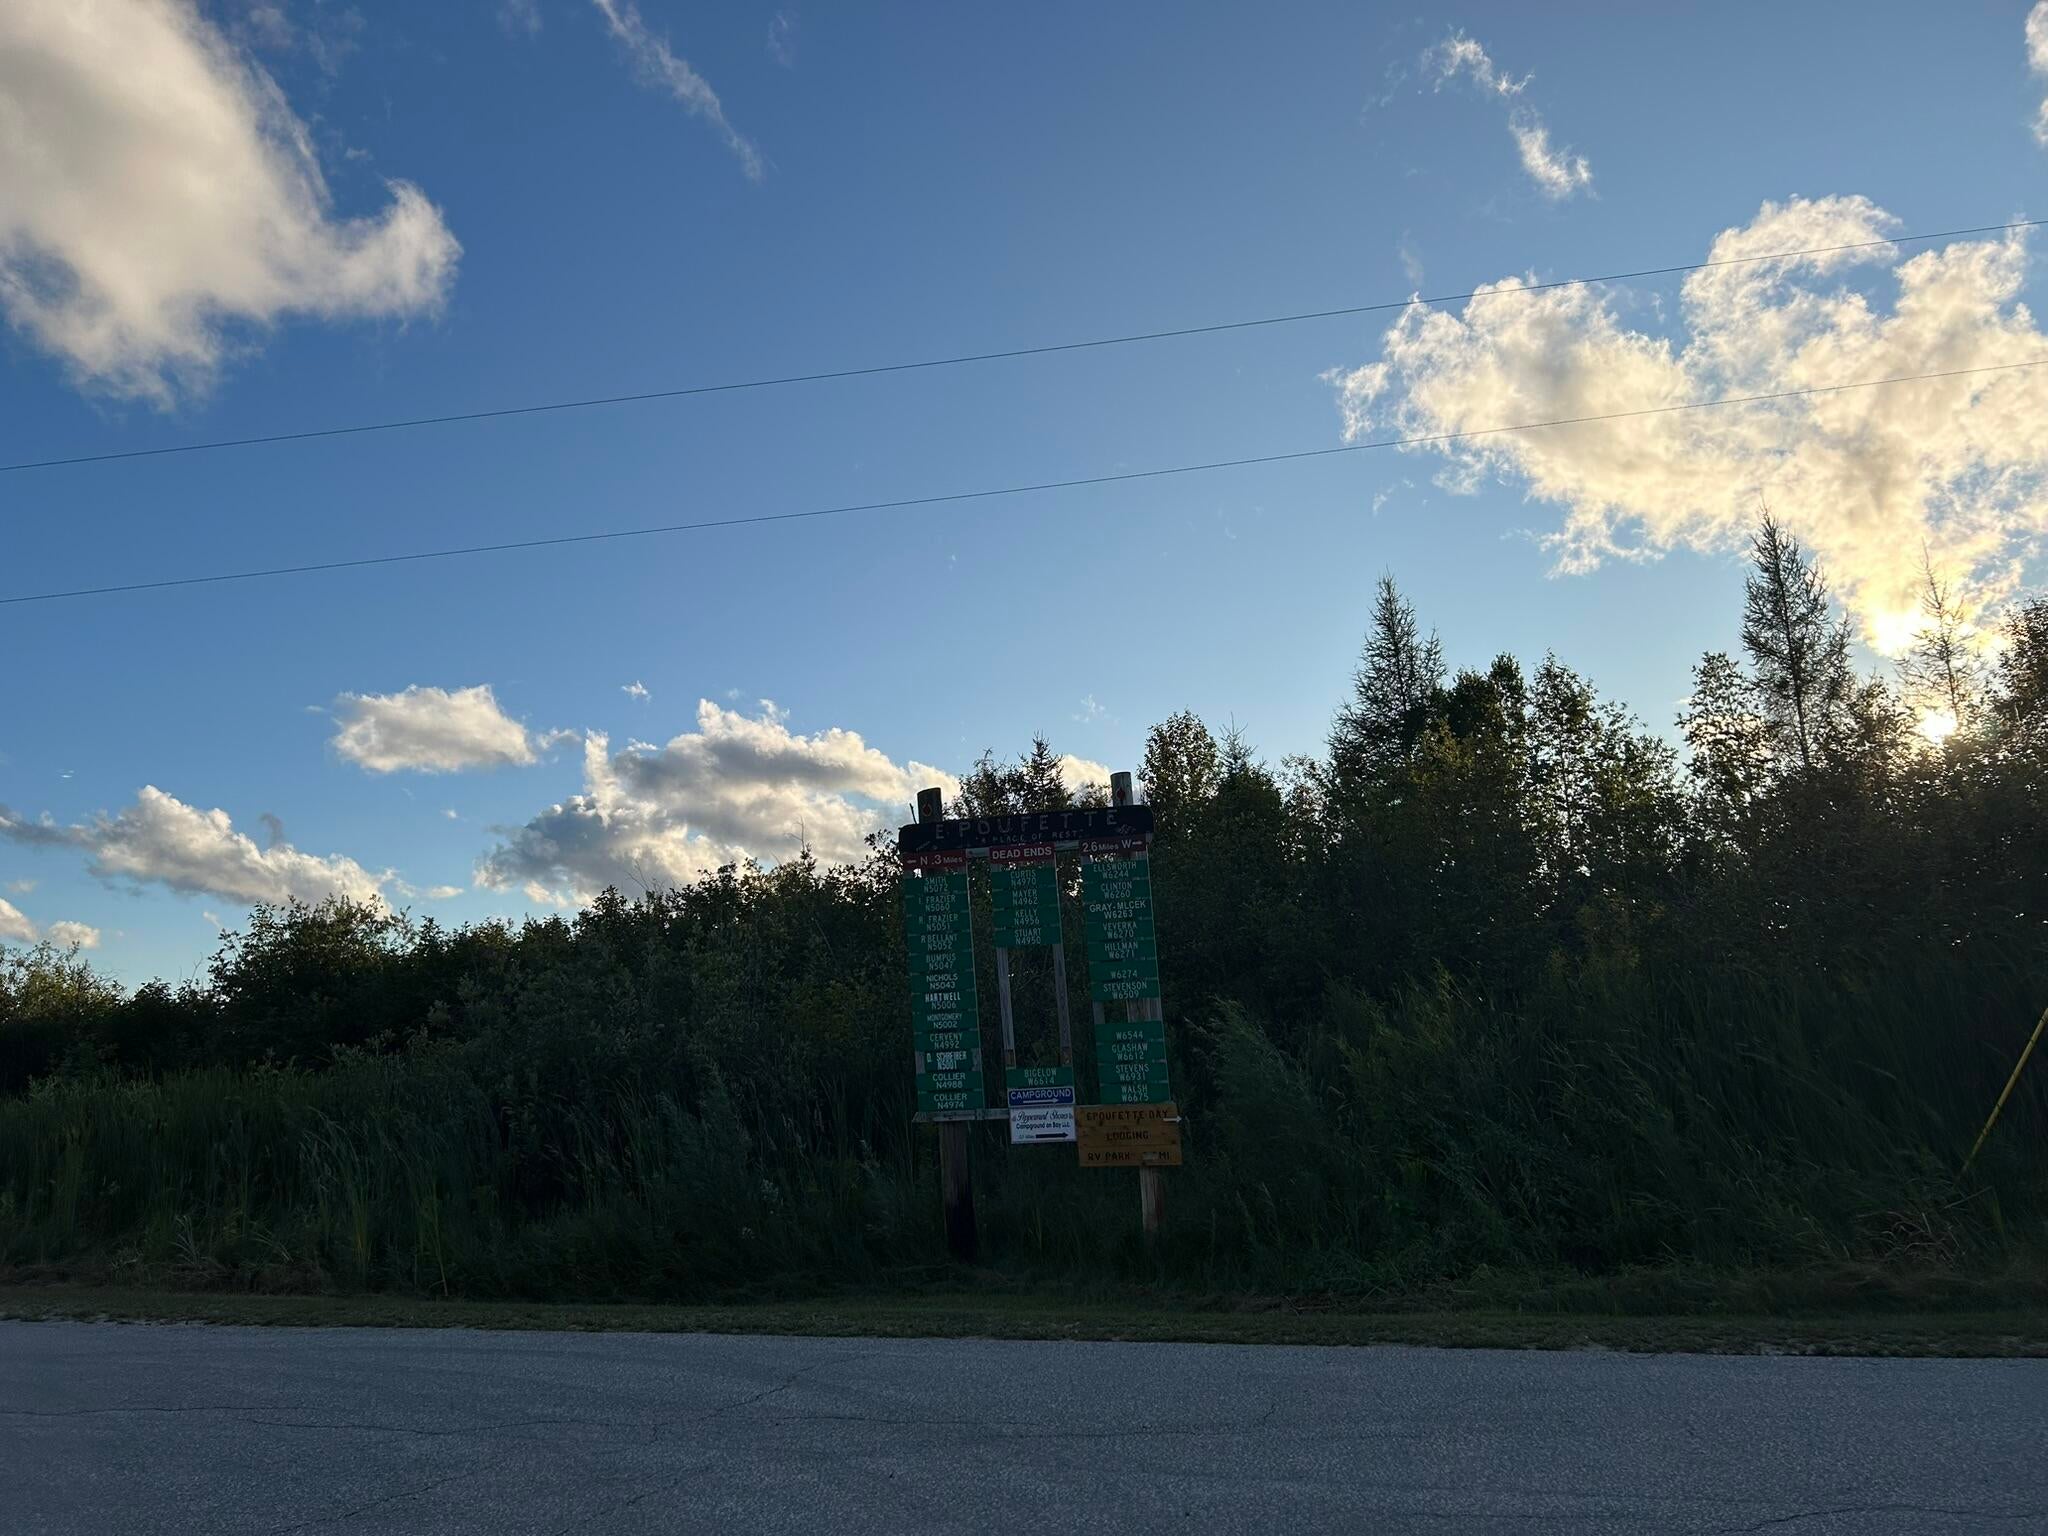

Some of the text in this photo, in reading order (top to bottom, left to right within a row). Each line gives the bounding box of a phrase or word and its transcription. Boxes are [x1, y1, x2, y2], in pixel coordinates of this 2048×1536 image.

[935, 809, 1118, 840] EPOUFETTE
[1098, 843, 1119, 851] Miles
[1122, 839, 1132, 849] W
[992, 846, 1052, 859] DEAD ENDS
[920, 856, 928, 865] N
[1093, 861, 1137, 872] ELLSWORTH
[1010, 869, 1037, 879] CURTIS
[1011, 877, 1037, 886] N4970
[1100, 880, 1132, 891] CLINTON
[1012, 888, 1038, 898] MAYER
[926, 895, 957, 904] FRAZIER
[1013, 897, 1039, 906] N4962
[1089, 900, 1146, 912] GRAY-MLCEK
[1014, 908, 1038, 918] KELLY
[928, 914, 959, 923] FRAZIER
[1014, 928, 1041, 938] STUART
[1016, 936, 1042, 945] N4950
[1104, 941, 1138, 951] HILLMAN
[926, 973, 959, 983] NICHOLS
[1110, 969, 1138, 979] W6274
[930, 981, 956, 990] N5043
[1103, 980, 1147, 992] STEVENSON
[933, 1020, 958, 1029] N5002
[1115, 1031, 1144, 1040] W6544
[1112, 1042, 1148, 1053] GLASHAW
[1024, 1067, 1057, 1078] BIGELOW
[1115, 1063, 1150, 1073] STEVENS
[933, 1072, 966, 1082] COLLIER
[936, 1080, 963, 1090] N4988
[1121, 1084, 1148, 1094] WALSH
[934, 1093, 967, 1102] COLLIER
[1010, 1089, 1072, 1100] CAMPGROUND
[938, 1101, 964, 1110] N4974
[1086, 1110, 1145, 1121] EPOUFETTE
[1016, 1122, 1046, 1131] Campground
[1105, 1130, 1149, 1141] LODGING
[1087, 1151, 1170, 1161] RV PARK MI
